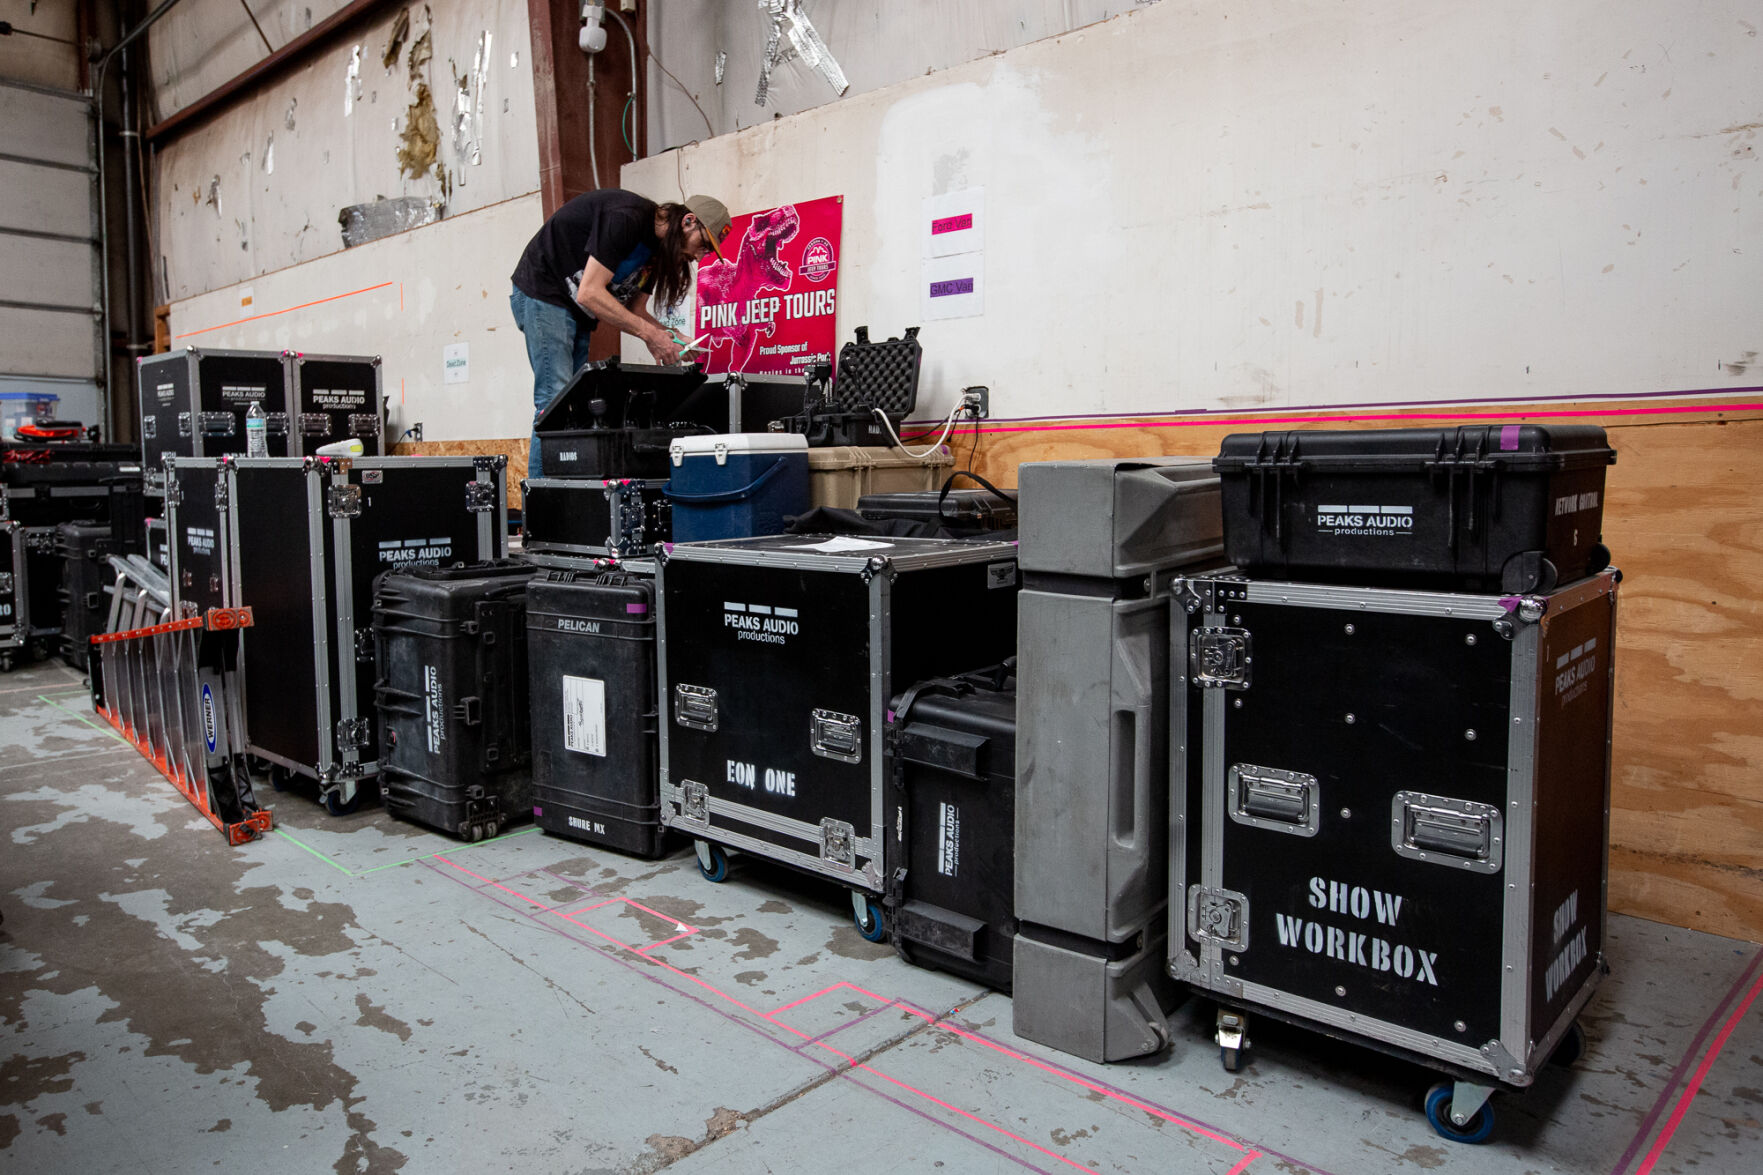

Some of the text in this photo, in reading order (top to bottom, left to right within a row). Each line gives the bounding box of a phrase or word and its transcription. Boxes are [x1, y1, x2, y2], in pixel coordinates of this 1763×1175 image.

[932, 216, 973, 232] Ford Van
[807, 254, 828, 264] PINK
[930, 280, 974, 295] GMC Van
[700, 288, 836, 330] PINK JEEP TOURS
[759, 341, 809, 356] Proud Sponsor of
[790, 353, 817, 365] Jurassic
[313, 395, 365, 405] PEAKS AUDIO
[1317, 514, 1413, 528] PEAKS AUDIO
[1334, 527, 1395, 536] productions
[379, 546, 452, 562] PEAKS AUDIO
[393, 558, 440, 570] productions
[557, 618, 601, 633] PELICAN
[724, 613, 799, 635] PEAKS AUDIO
[737, 630, 786, 645] productions
[1554, 654, 1596, 696] PEAKS AUDIO
[204, 698, 214, 739] WERNER
[430, 666, 440, 754] PEAKS AUDIO
[437, 684, 446, 740] productions
[727, 759, 796, 797] EON ONE
[568, 815, 606, 835] SHURE MX
[945, 804, 955, 876] PEAKS AUDIO
[1308, 876, 1403, 927] SHOW
[1553, 888, 1578, 944] SHOW
[1275, 912, 1439, 986] WORKBOX
[1545, 924, 1587, 1003] WORKBOX
